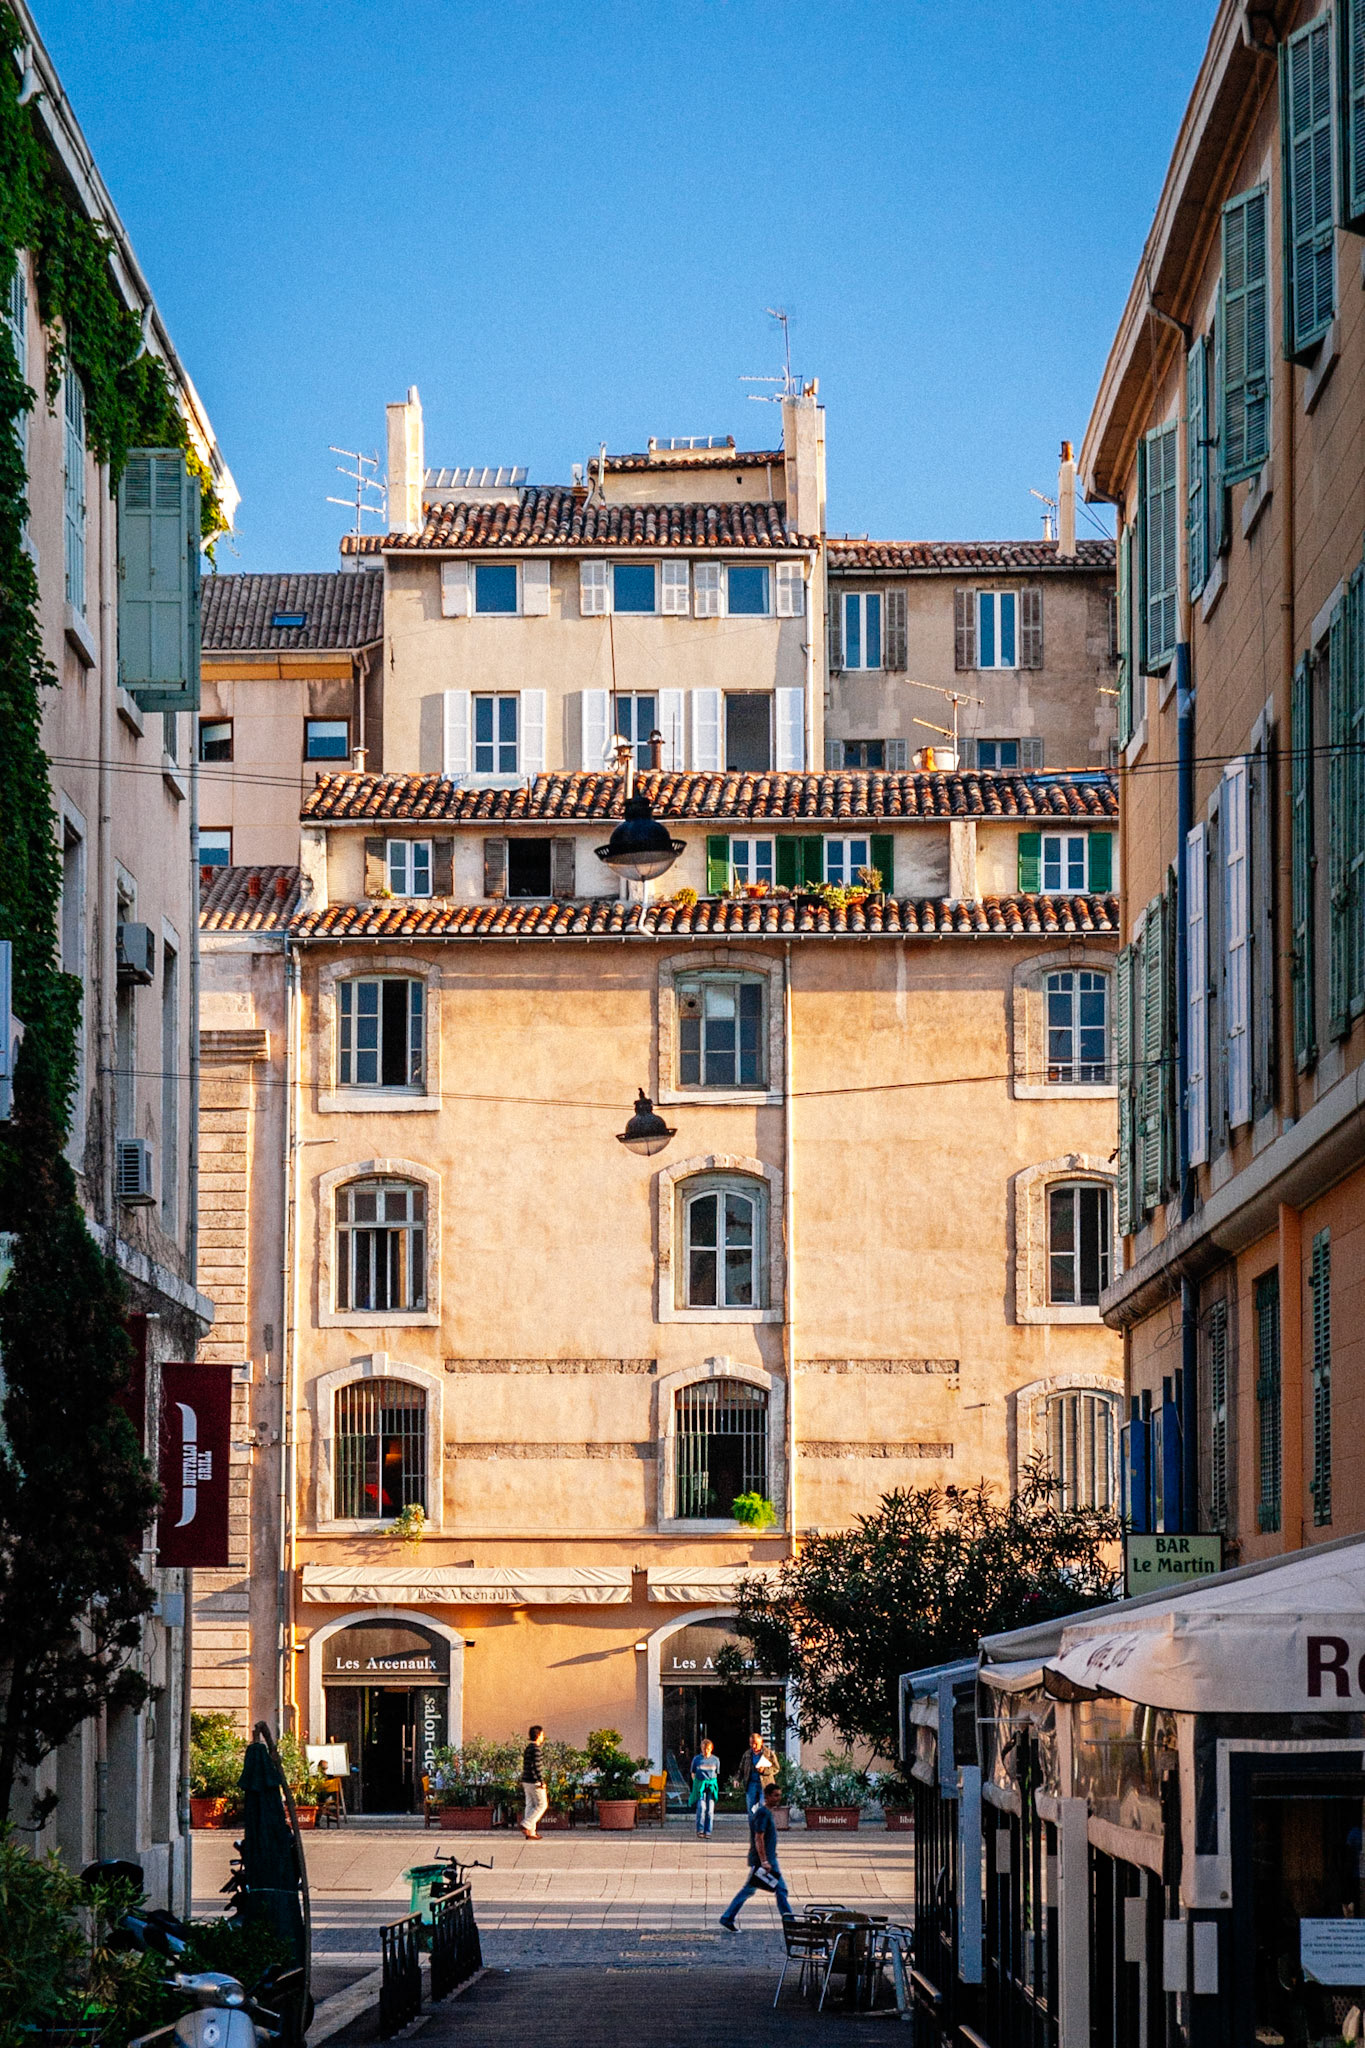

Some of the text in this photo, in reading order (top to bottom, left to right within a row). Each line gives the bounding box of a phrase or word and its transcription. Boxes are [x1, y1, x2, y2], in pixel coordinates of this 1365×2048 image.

[182, 1444, 197, 1487] BUFFALO
[198, 1450, 212, 1480] GRILL
[1156, 1538, 1190, 1553] BAR
[1133, 1557, 1215, 1573] Le Martin
[418, 1588, 518, 1600] Les Arcenaulx
[336, 1656, 437, 1670] Les Arcenaulx
[672, 1656, 697, 1669] Les
[1307, 1635, 1365, 1698] R
[818, 1815, 848, 1824] librairie
